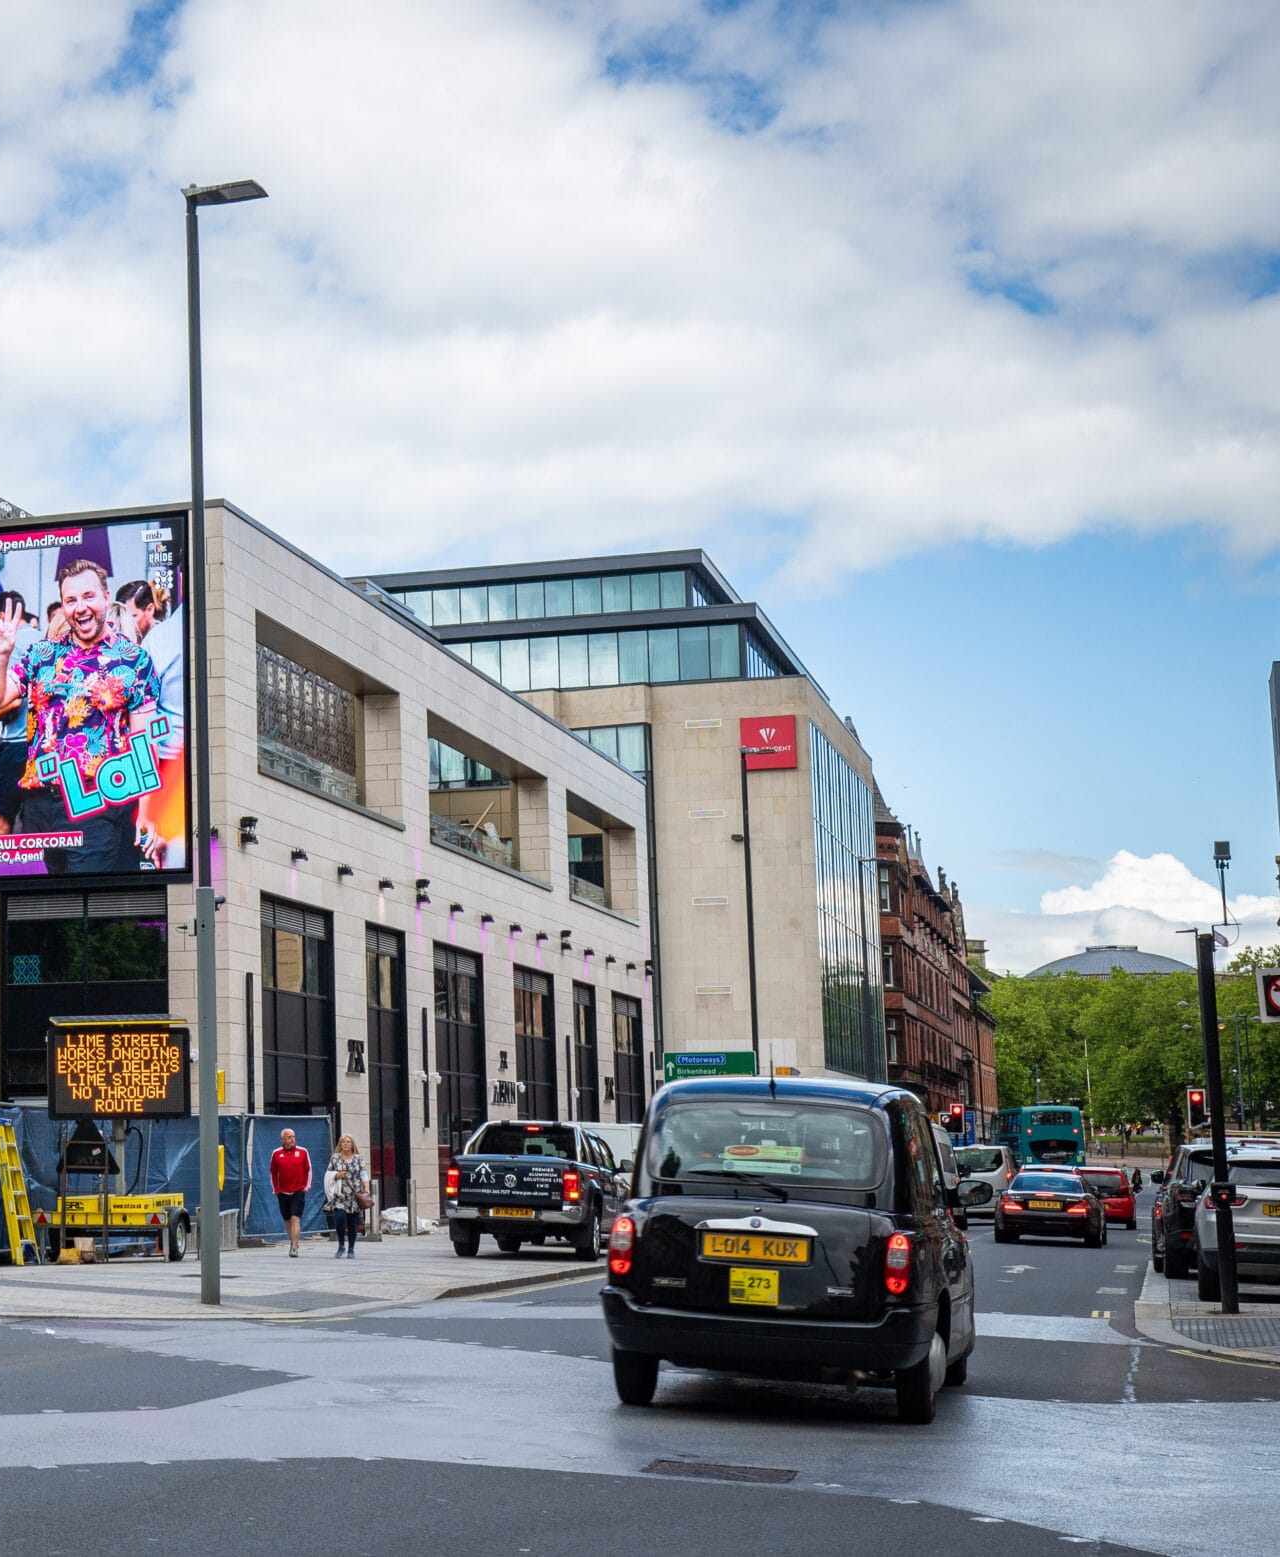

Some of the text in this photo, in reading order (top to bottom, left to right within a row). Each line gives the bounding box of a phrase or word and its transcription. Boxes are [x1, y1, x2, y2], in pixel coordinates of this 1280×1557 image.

[20, 834, 83, 848] CORCORAN
[14, 850, 44, 864] Agent
[66, 1034, 170, 1048] LIME STREET
[57, 1046, 180, 1061] WORKS ONGOING
[677, 1055, 725, 1065] (Motorways)
[57, 1060, 180, 1074] EXPECT DELAYS
[67, 1072, 170, 1087] LIME STREET
[72, 1086, 166, 1100] NO THROUGH
[95, 1099, 144, 1113] ROUTE
[470, 1173, 496, 1184] PAS
[763, 1240, 799, 1258] KUX
[747, 1276, 771, 1290] 273
